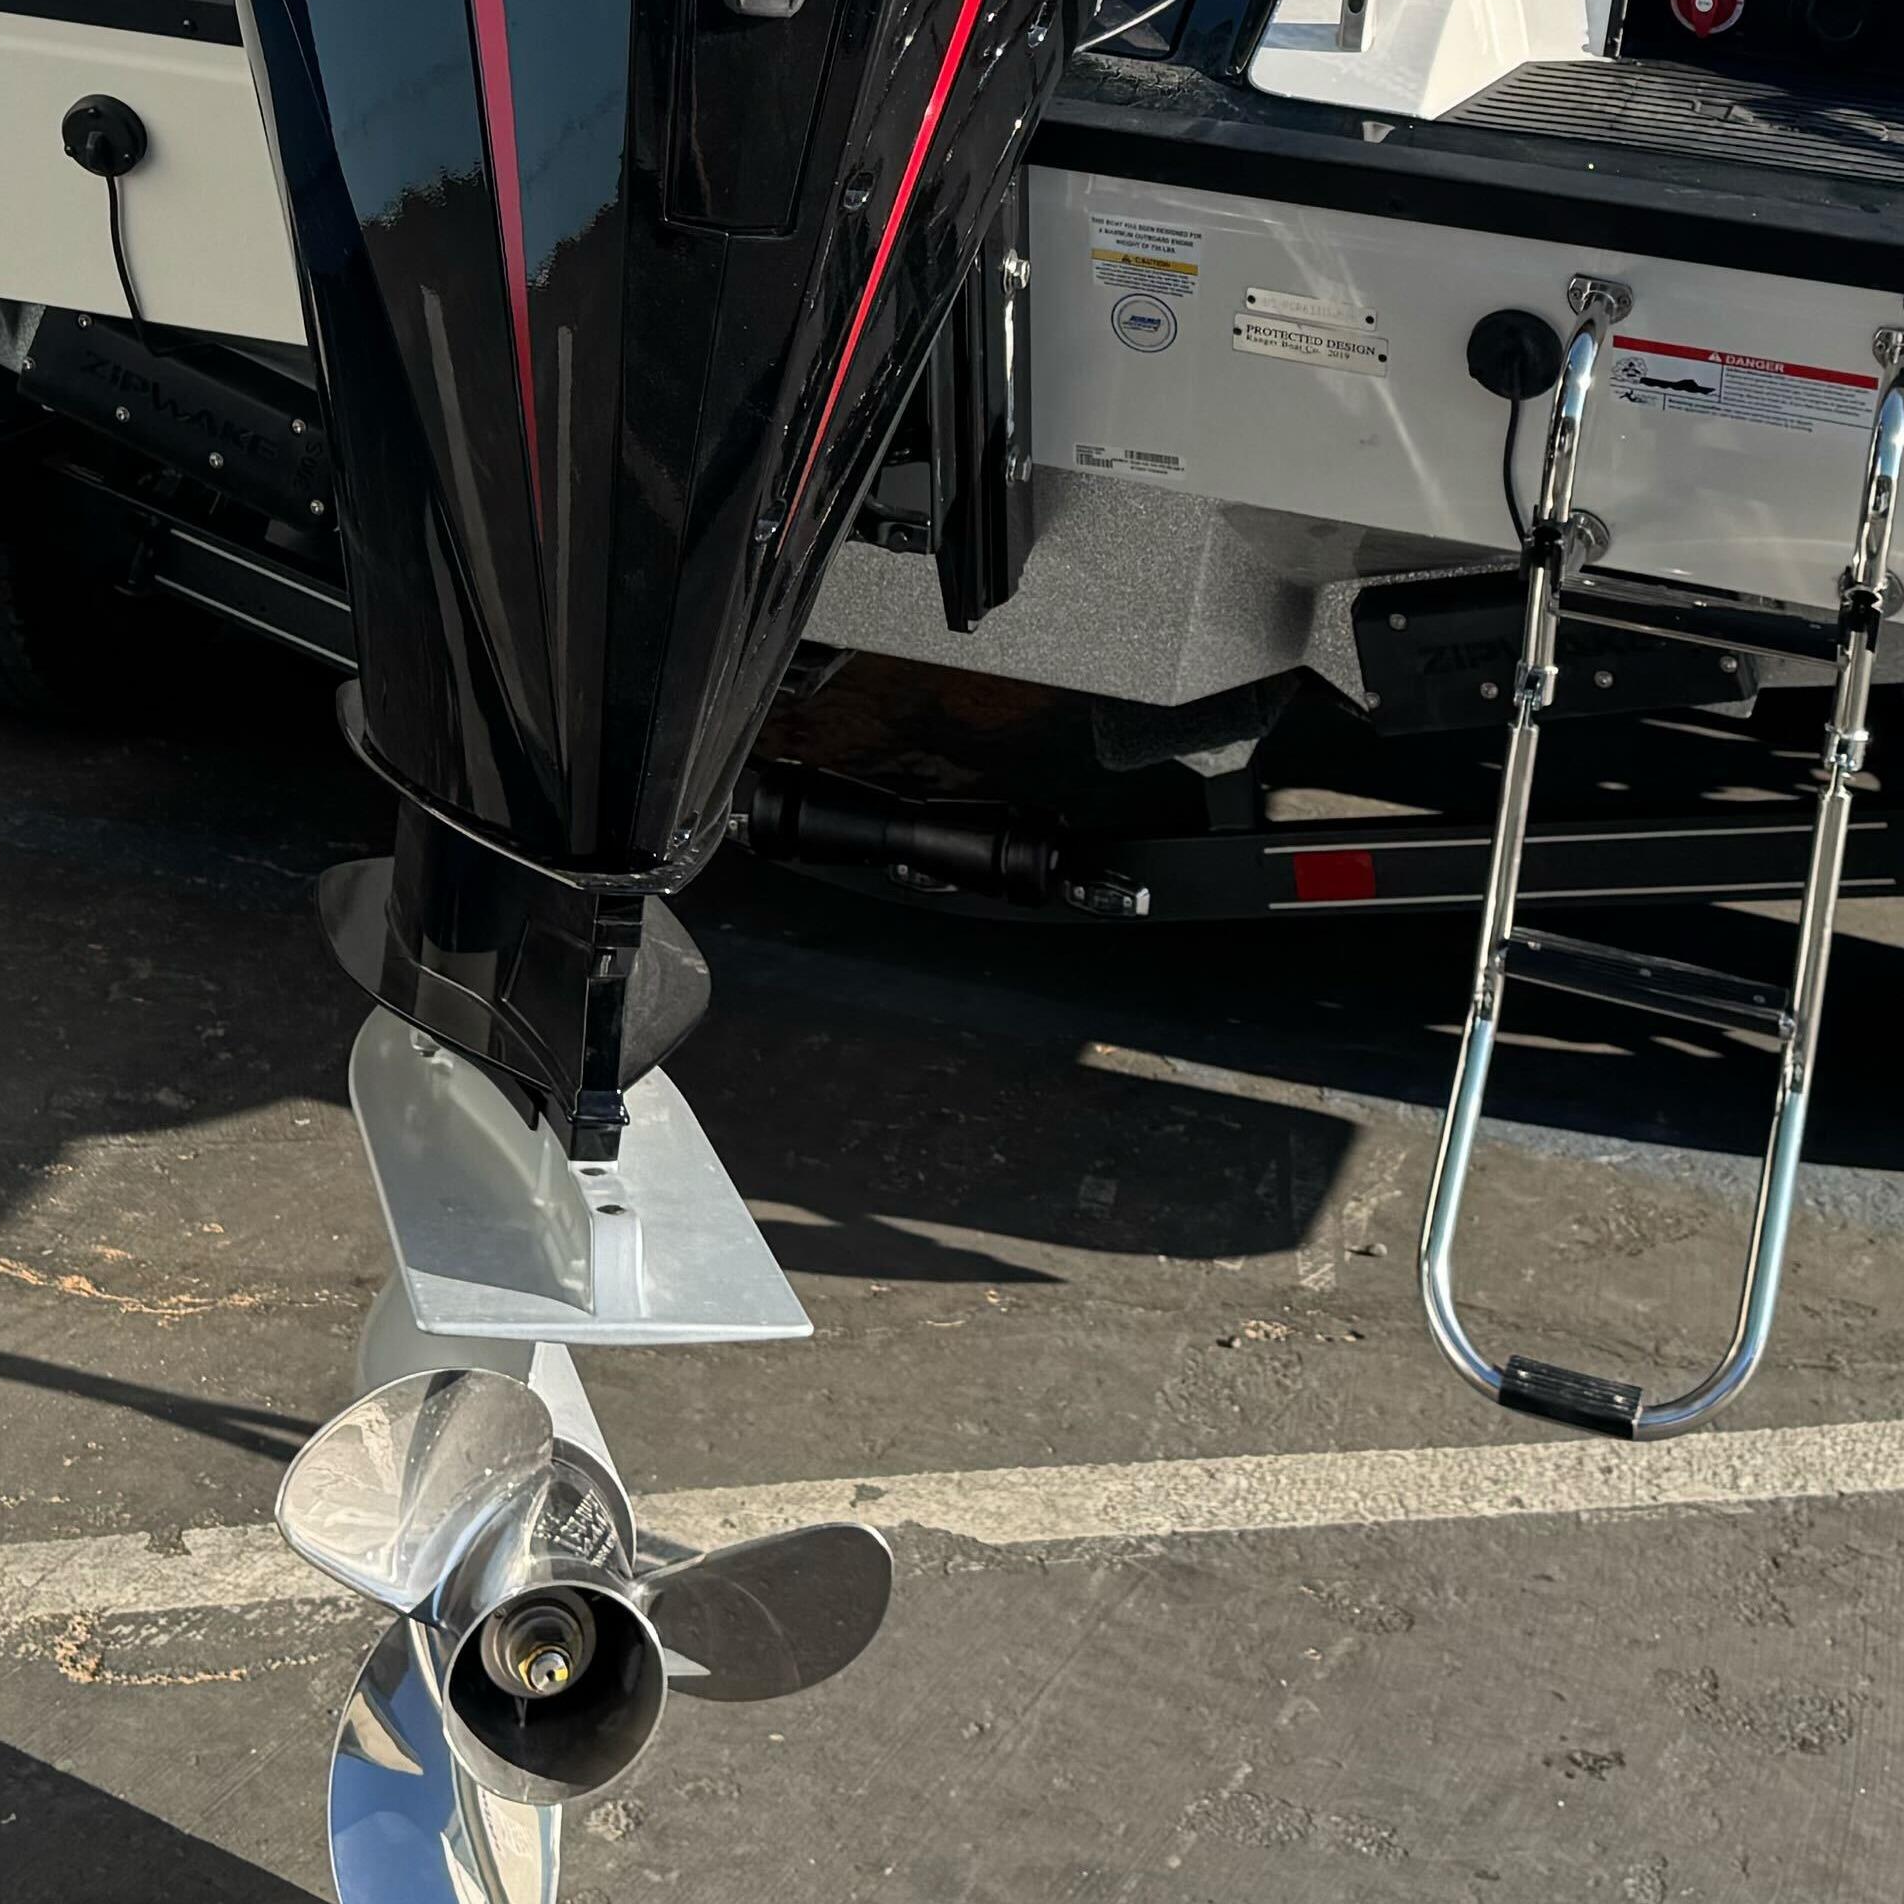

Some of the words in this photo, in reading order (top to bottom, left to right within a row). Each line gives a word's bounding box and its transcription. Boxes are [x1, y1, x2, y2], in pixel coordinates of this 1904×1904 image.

[1246, 324, 1324, 347] PROTECTED
[1326, 339, 1376, 356] DESIGN
[1725, 354, 1785, 374] DANGER
